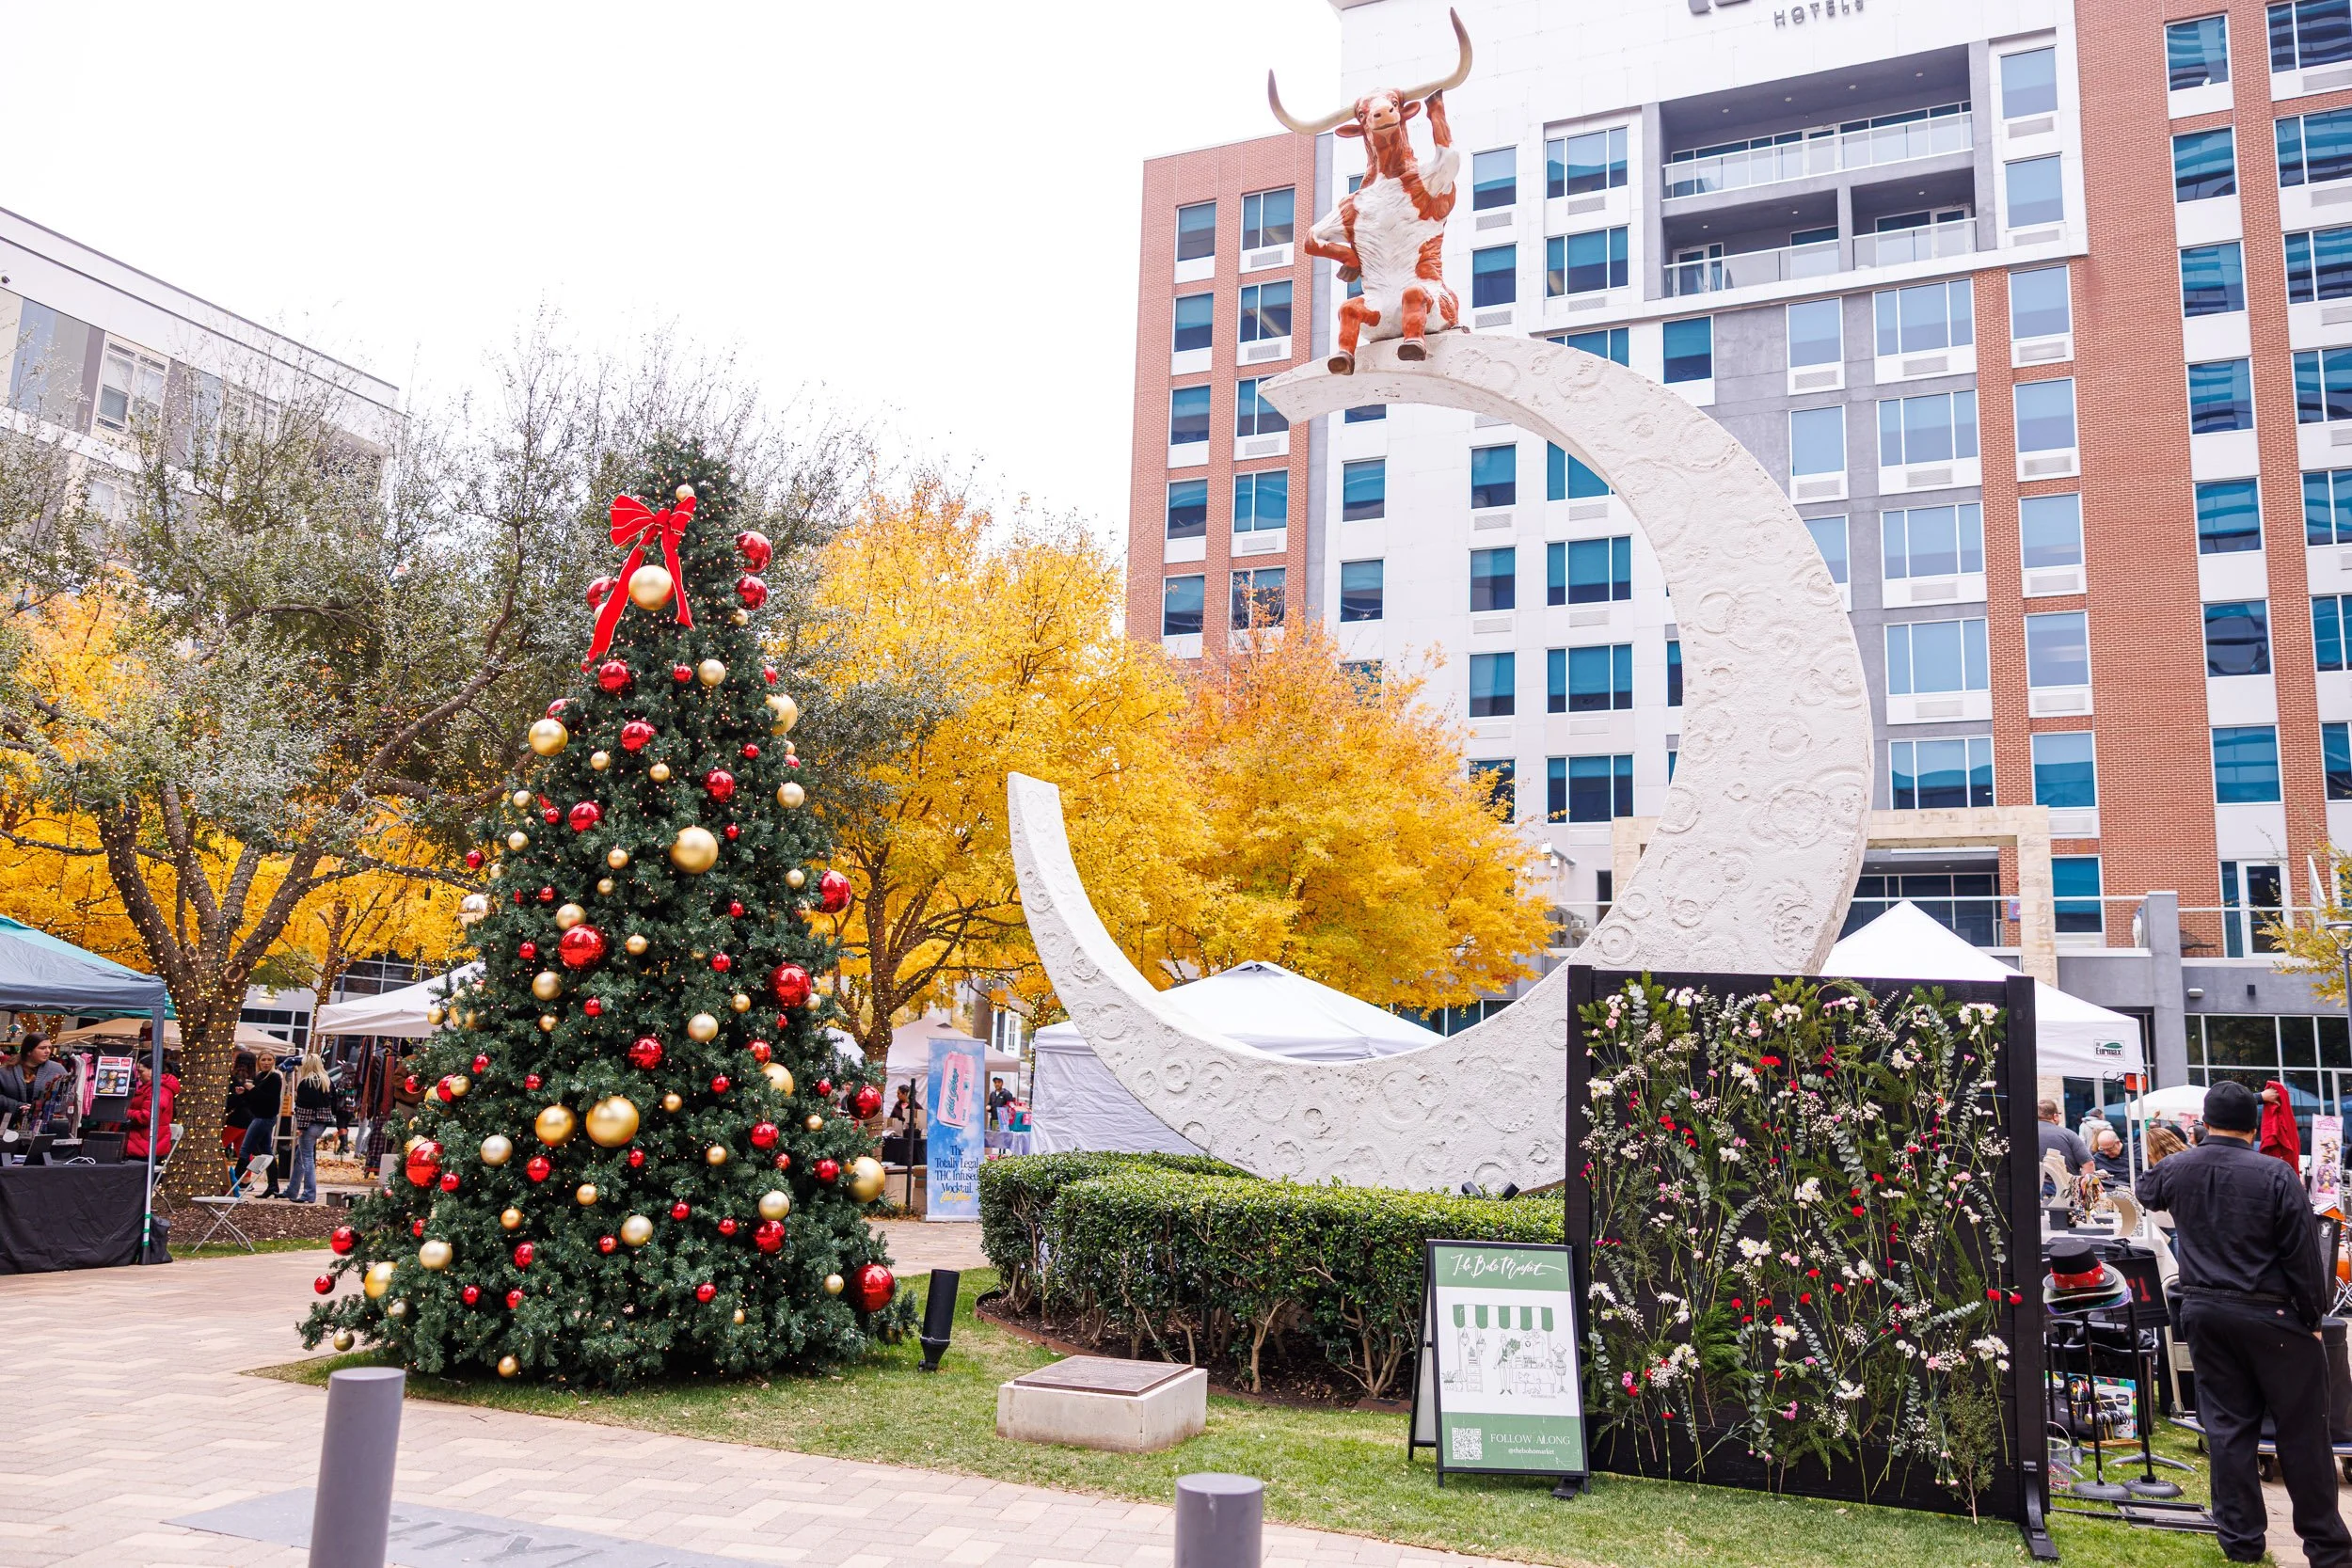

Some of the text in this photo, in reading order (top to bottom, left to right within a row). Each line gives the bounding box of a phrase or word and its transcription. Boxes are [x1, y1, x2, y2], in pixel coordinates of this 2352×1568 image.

[1773, 0, 1865, 27] HOTELS
[2095, 1047, 2122, 1055] Eurmax
[949, 1145, 964, 1156] The
[934, 1157, 978, 1171] Totally Legal
[934, 1169, 979, 1181] THC Infused
[1450, 1254, 1564, 1280] The Boho Market
[1490, 1433, 1570, 1446] FOLLOW ALONG
[1508, 1447, 1554, 1455] @thebohomarket
